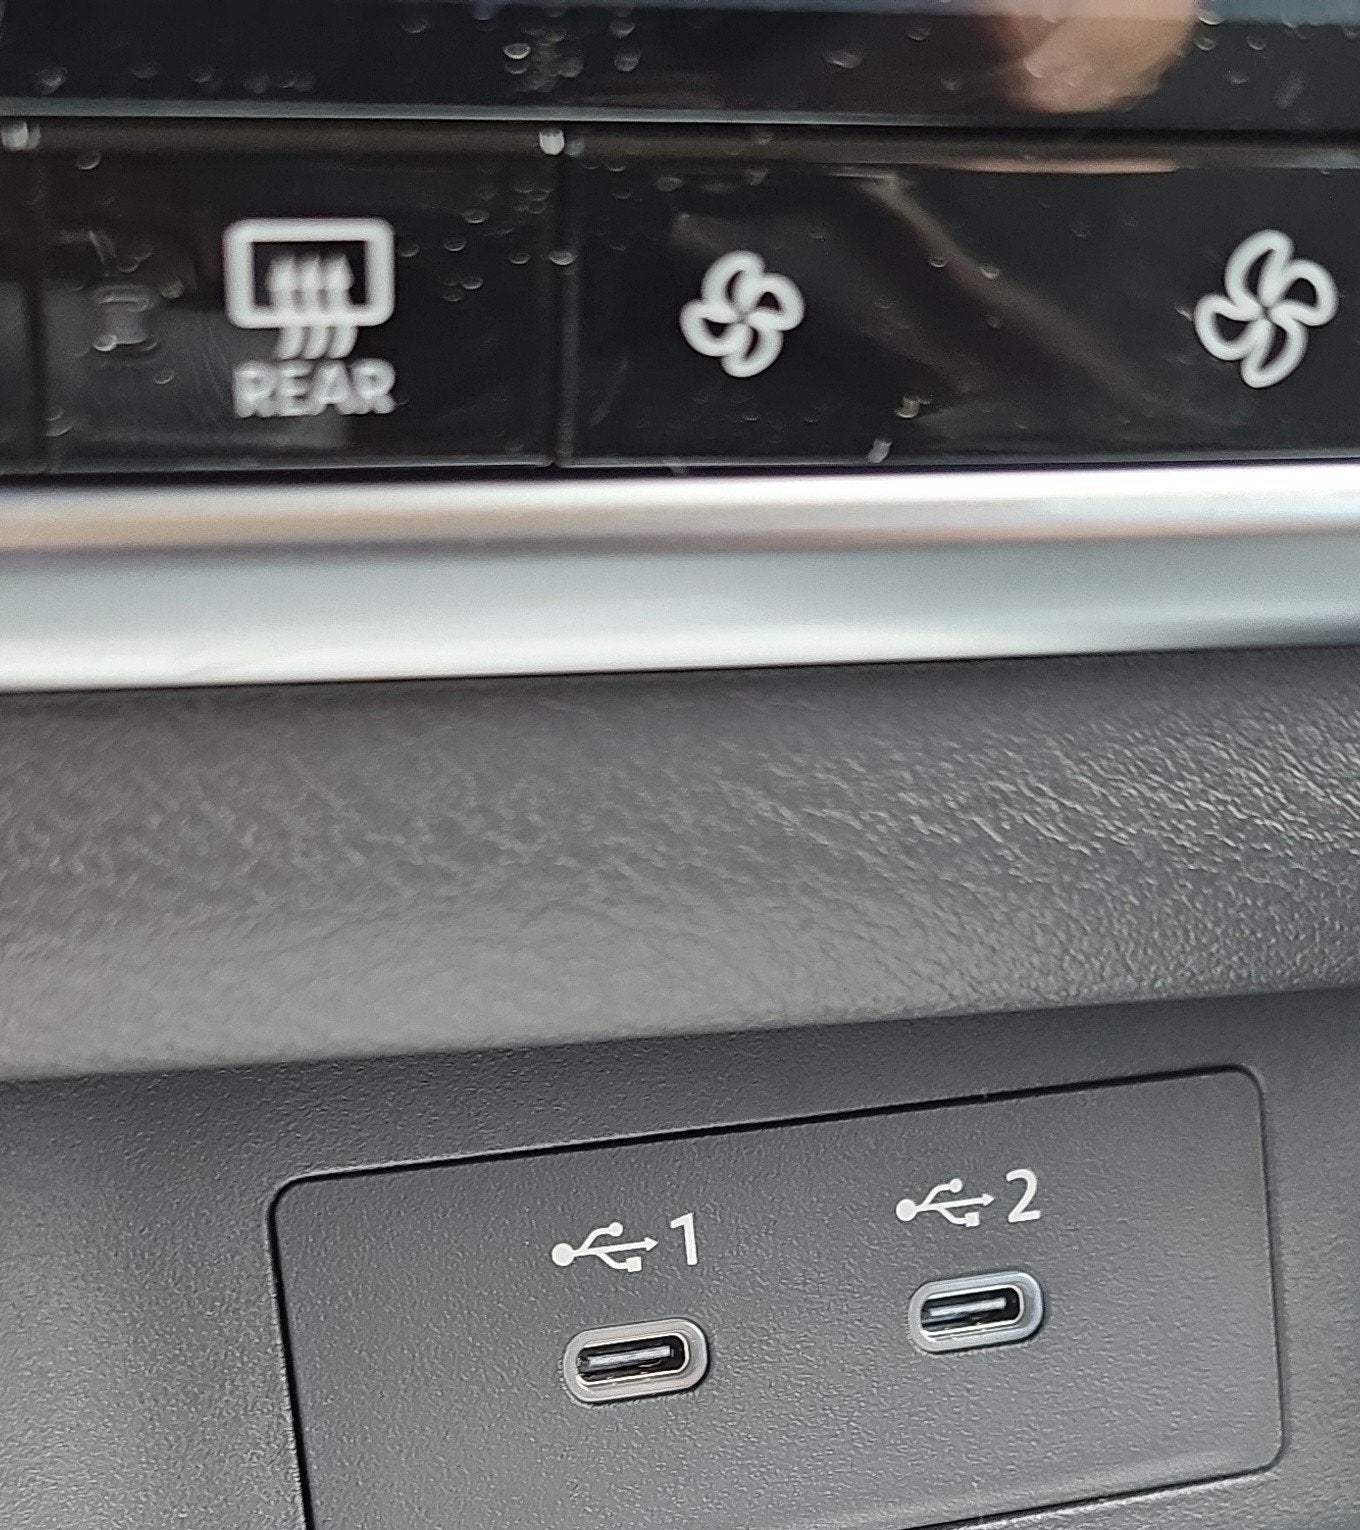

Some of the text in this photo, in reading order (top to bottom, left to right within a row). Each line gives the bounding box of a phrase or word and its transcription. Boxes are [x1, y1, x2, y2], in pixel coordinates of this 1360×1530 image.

[233, 358, 396, 418] REAR
[1006, 1168, 1040, 1223] 2
[670, 1213, 698, 1266] 1
